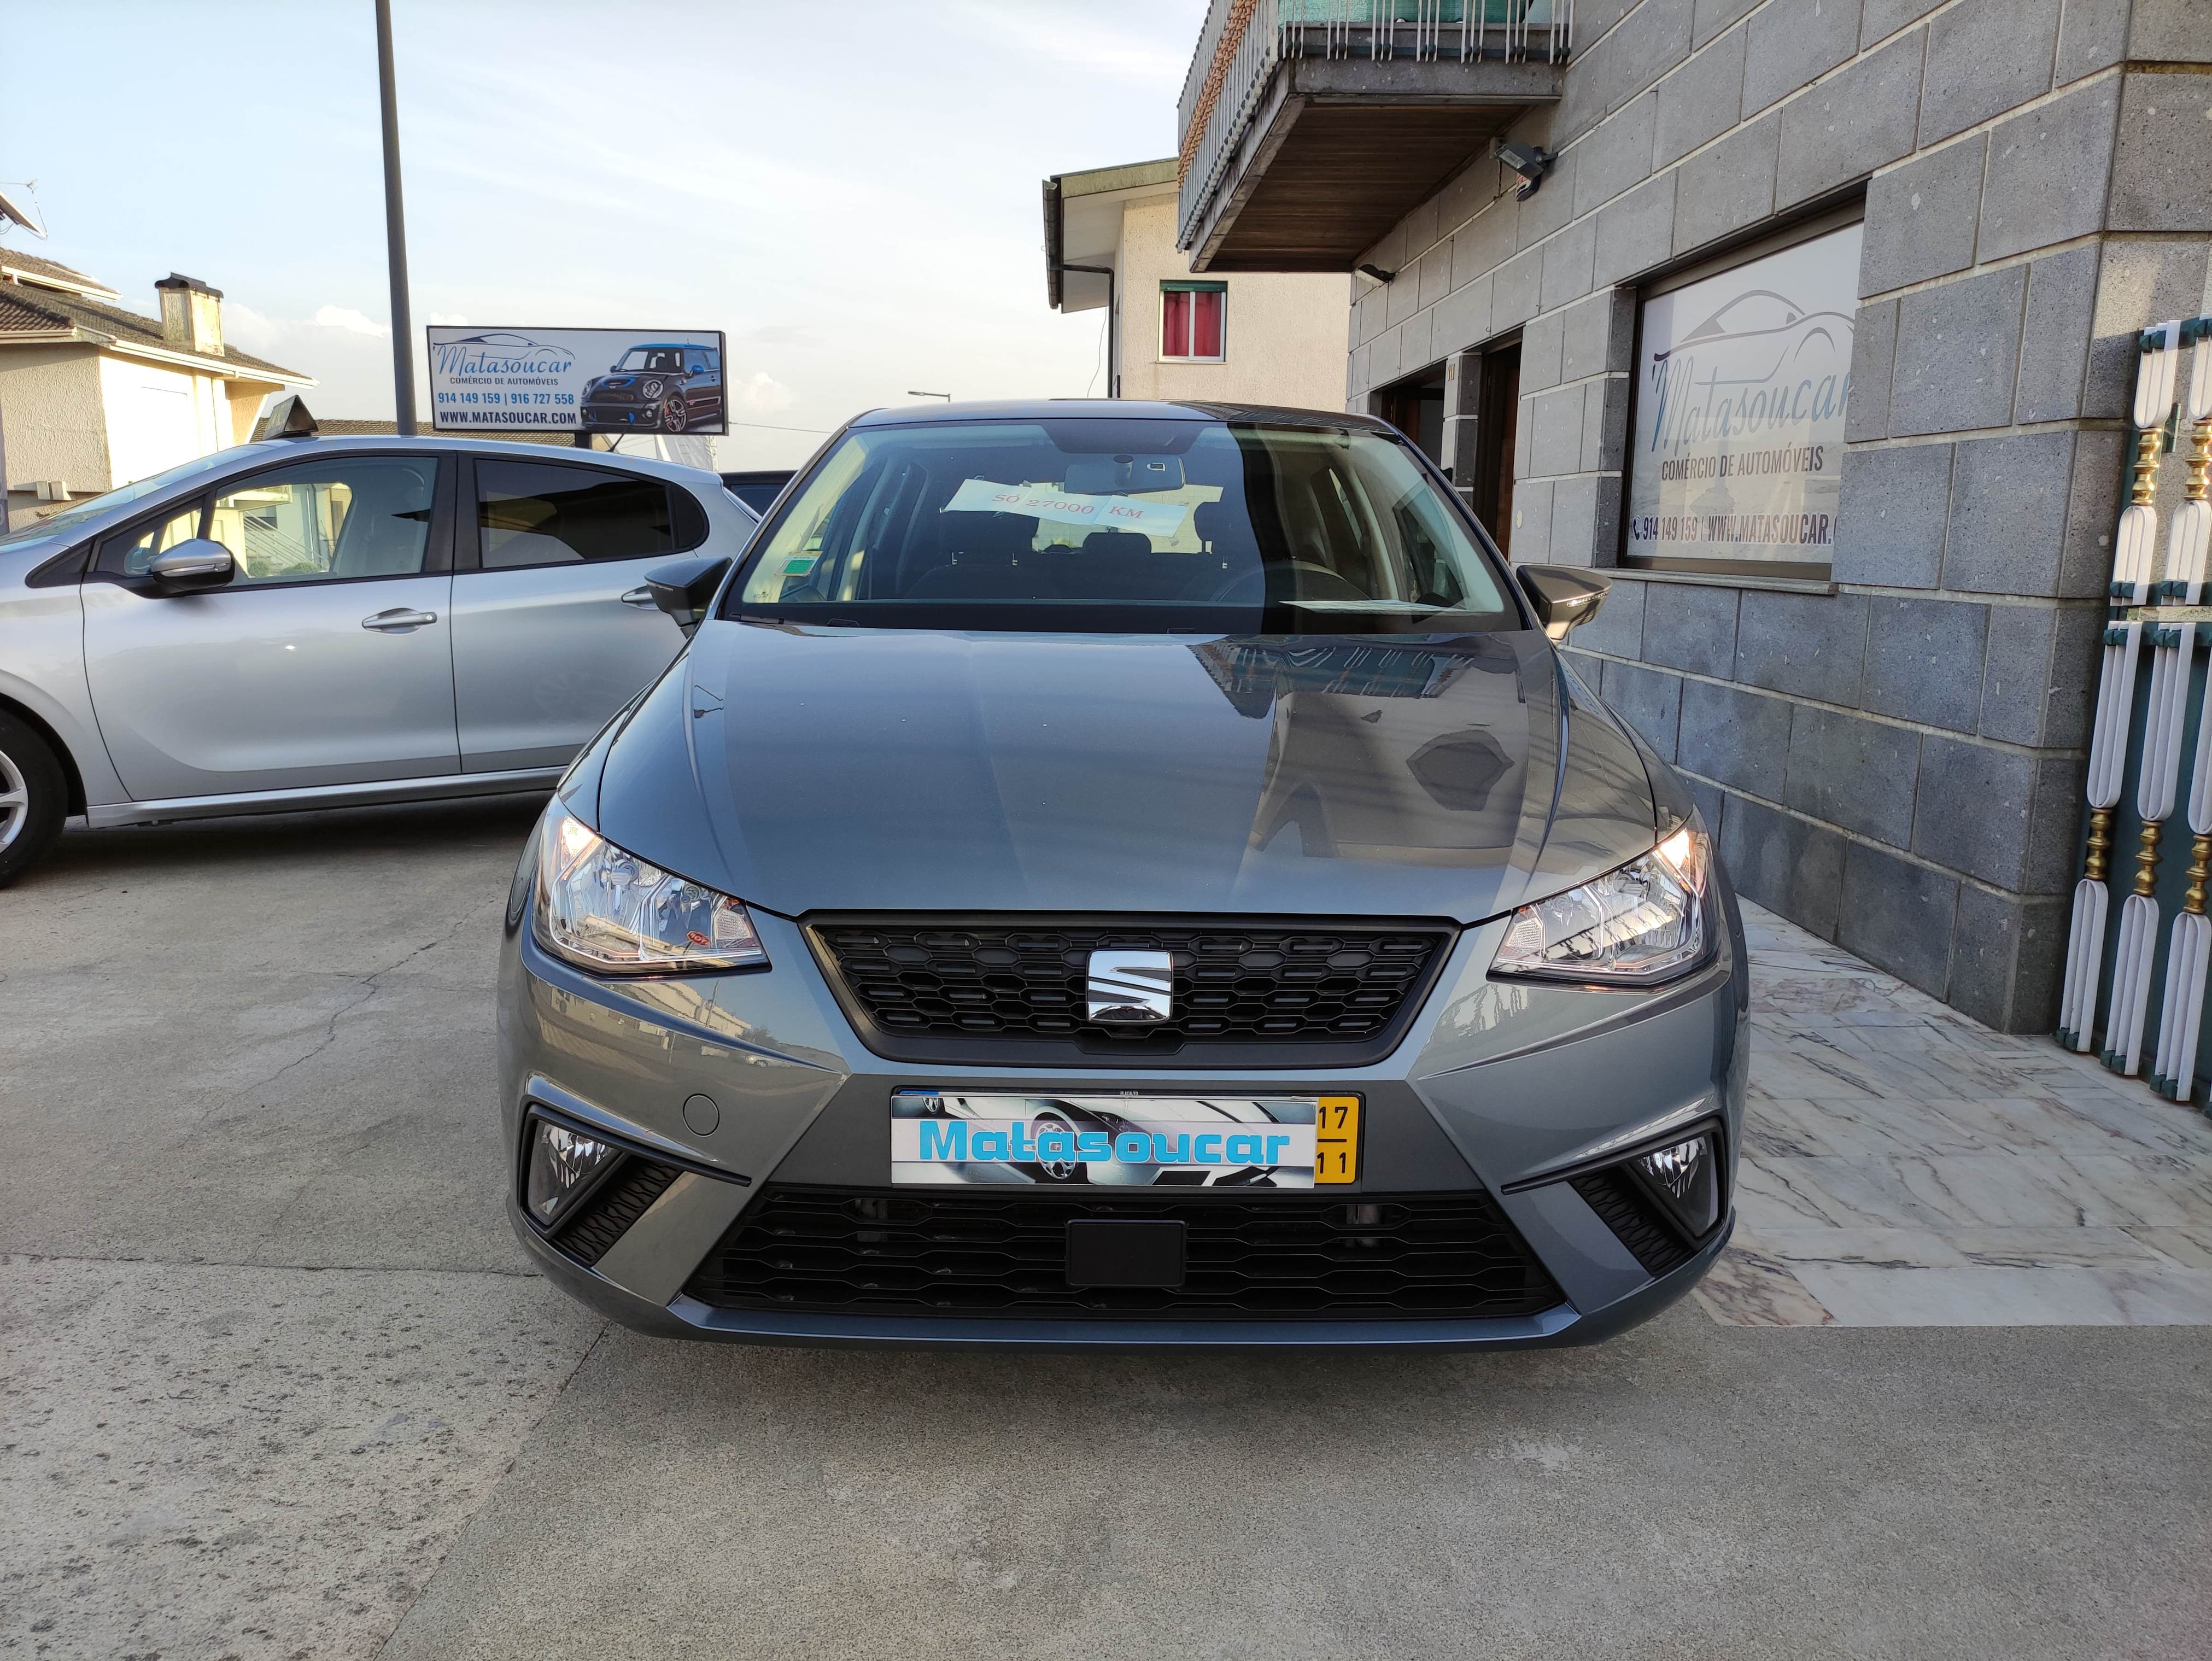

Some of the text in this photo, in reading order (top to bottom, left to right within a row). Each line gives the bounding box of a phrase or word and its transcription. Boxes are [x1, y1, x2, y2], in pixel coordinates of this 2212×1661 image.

[438, 346, 571, 377] Matasoucar
[450, 375, 492, 384] COMÉRCIO
[507, 376, 559, 385] AUTOMÓVEIS
[438, 393, 457, 403] 914
[460, 393, 478, 403] 149
[482, 393, 500, 404] 159
[511, 393, 530, 405] 916
[533, 394, 551, 405] 727
[555, 394, 575, 405] 558
[440, 411, 577, 424] WWW.MATASOUCAR.COM
[1662, 441, 1824, 481] COMÉRCIO DE AUTOMÓVEIS
[992, 494, 1144, 518] SÓ 27000 KM
[1643, 517, 1659, 540] 914
[1662, 516, 1678, 541] 149
[1681, 516, 1698, 541] 159
[1319, 1106, 1348, 1129] 17
[919, 1120, 1290, 1165] Matasoucar
[1316, 1152, 1347, 1174] 11
